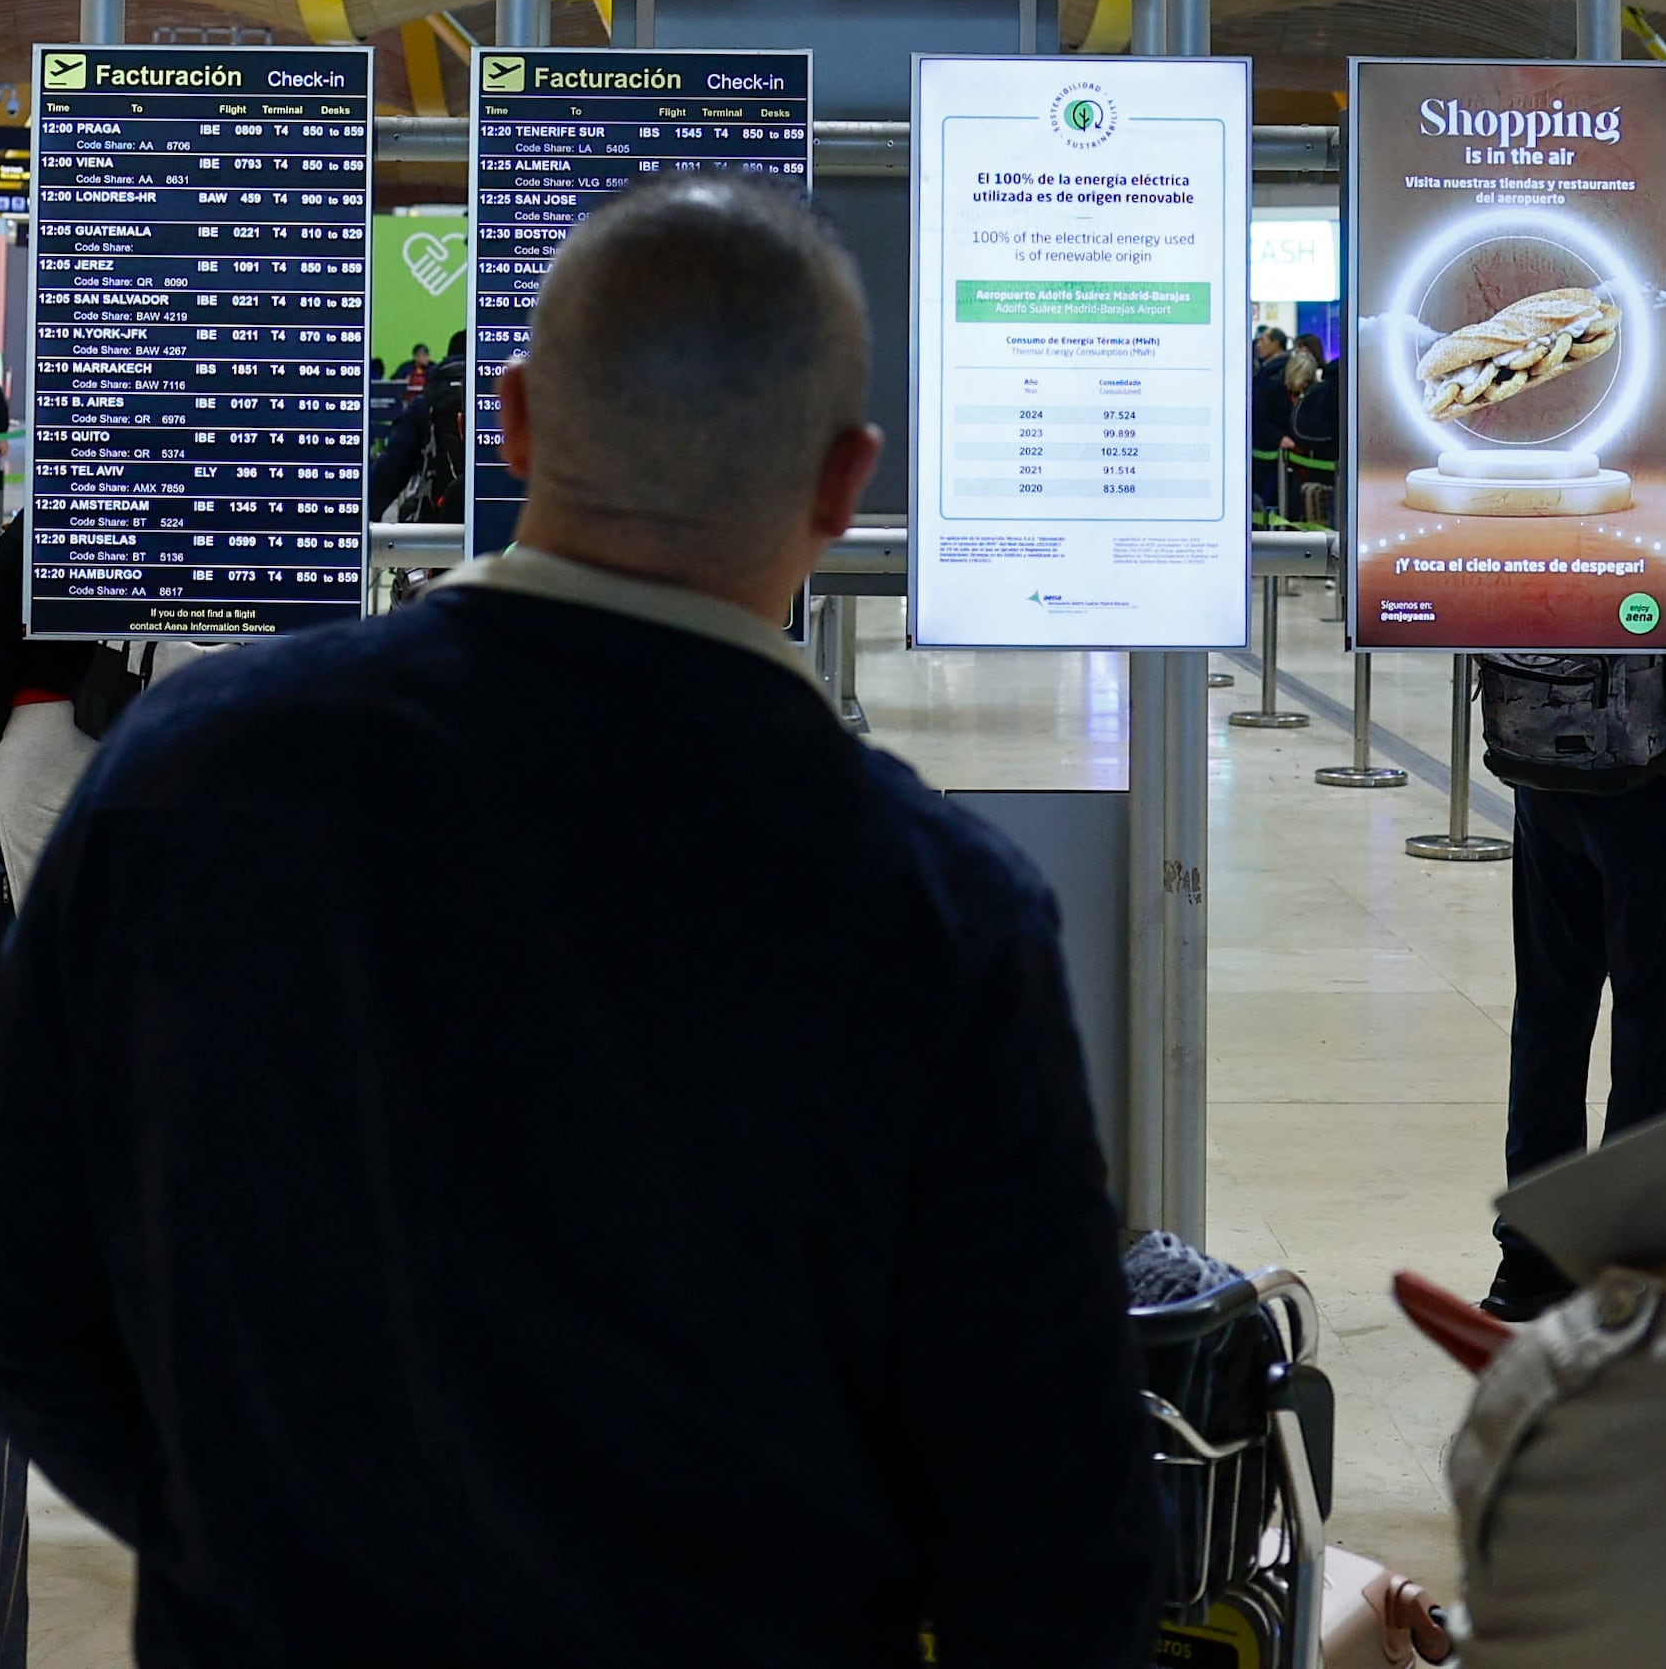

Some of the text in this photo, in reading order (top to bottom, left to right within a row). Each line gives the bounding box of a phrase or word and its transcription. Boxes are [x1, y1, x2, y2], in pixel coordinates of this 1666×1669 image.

[96, 65, 344, 87] Facturación Check-in
[535, 68, 784, 91] Facturación Check-in
[42, 123, 121, 134] 12:00 PRAGA
[1421, 98, 1621, 148] Shopping
[481, 126, 605, 137] 12:20 TENERIFE SUR
[1466, 147, 1575, 166] is in the air
[978, 173, 1189, 188] El 100% de la energía eléctrica
[1405, 176, 1635, 192] Visita nuestras tiendas y restaurantes
[973, 191, 1194, 205] utilizada es de origen renovable
[1476, 192, 1565, 206] del aeropuerto
[480, 229, 566, 240] 12:30 BOSTON
[972, 231, 1194, 247] 100% of the electrical energy used
[1015, 249, 1151, 264] is of renewable origin
[977, 290, 1191, 302] Aeropuerto Adolfo Suárez Madrid-Barajas
[1006, 336, 1159, 347] Consumo de Energía Térmica (MWh)
[1019, 410, 1135, 420] 2024 97.524
[1019, 429, 1135, 438] 2023 99.899
[1019, 448, 1138, 456] 2022 102.522
[36, 499, 149, 511] 12:20 AMSTERDAM
[1396, 558, 1645, 576] ¡Y toca el cielo antes de despegar!
[1381, 600, 1417, 611] Síguenos
[1630, 605, 1650, 613] enjoy
[1381, 612, 1435, 622] @enjoyaena
[1626, 613, 1653, 622] aena
